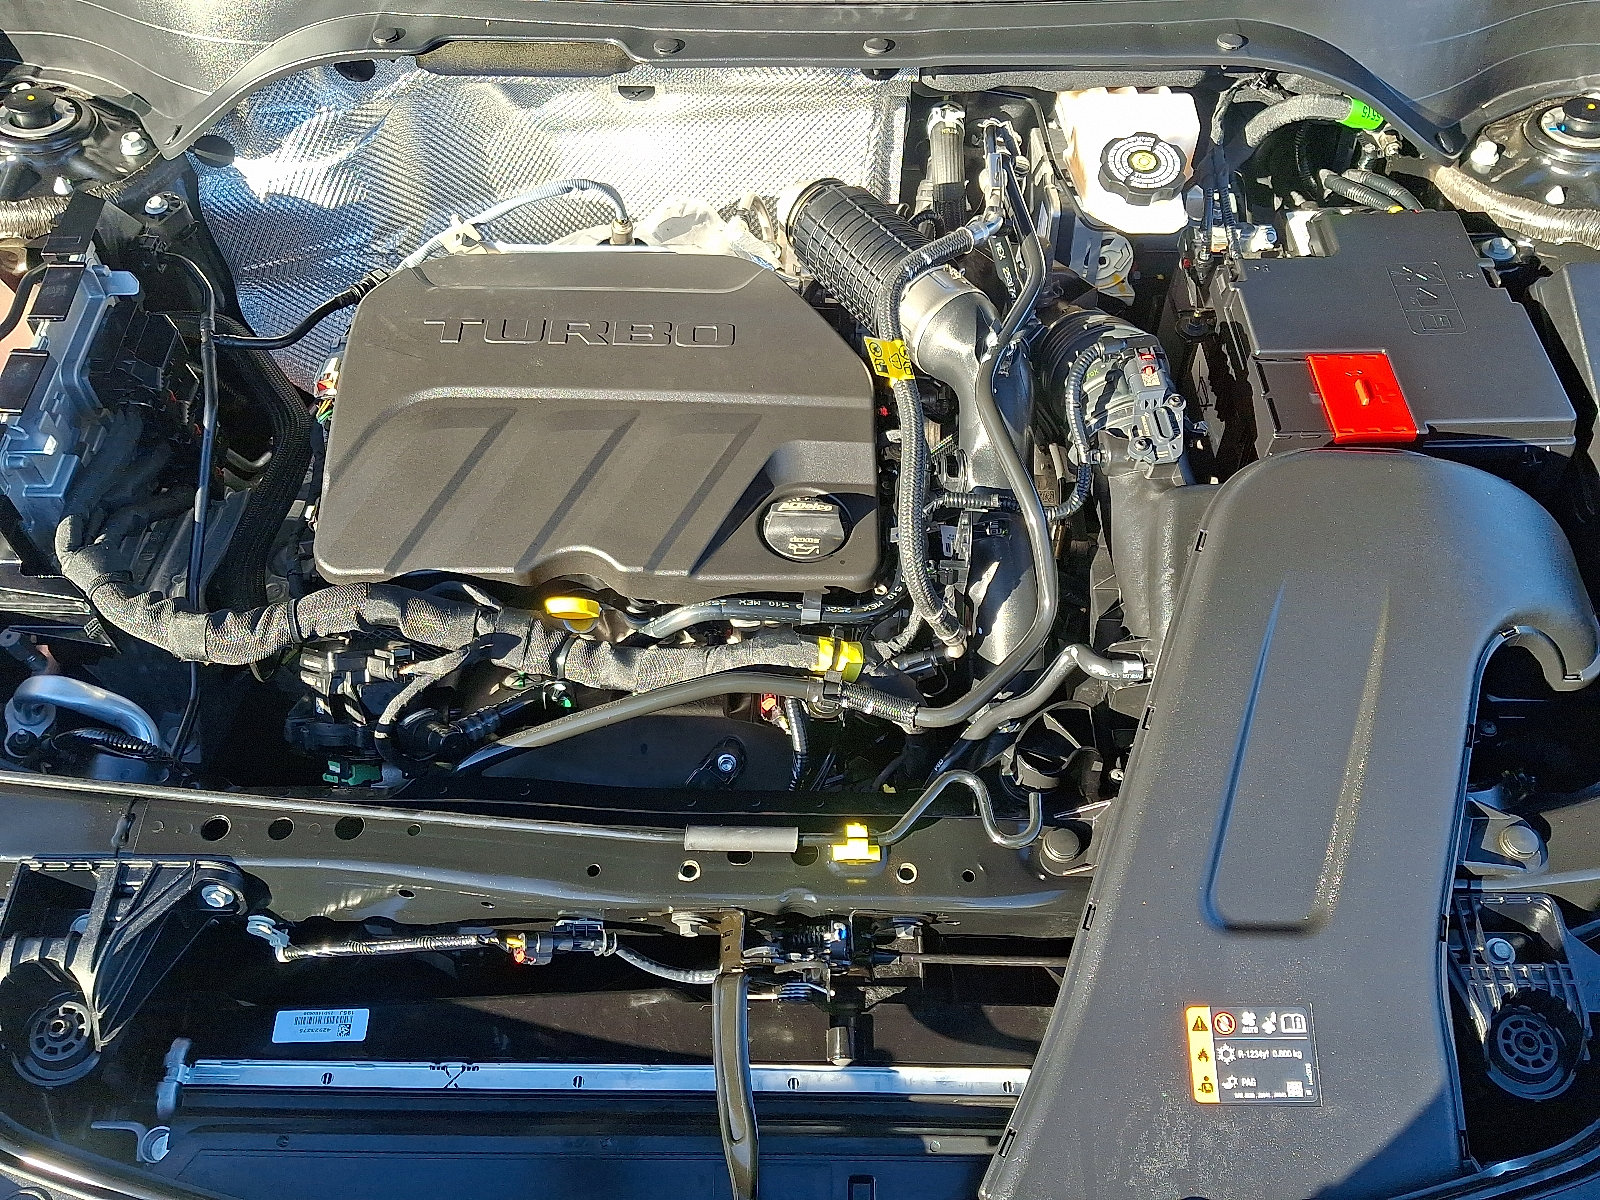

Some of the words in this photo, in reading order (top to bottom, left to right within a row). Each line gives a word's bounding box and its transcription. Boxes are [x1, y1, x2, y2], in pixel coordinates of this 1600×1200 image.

[994, 241, 1006, 261] MEX
[423, 317, 736, 348] TURBO
[738, 599, 761, 607] MEX
[861, 600, 885, 612] MEX
[1292, 1049, 1303, 1060] kg
[1241, 1077, 1257, 1087] PAG
